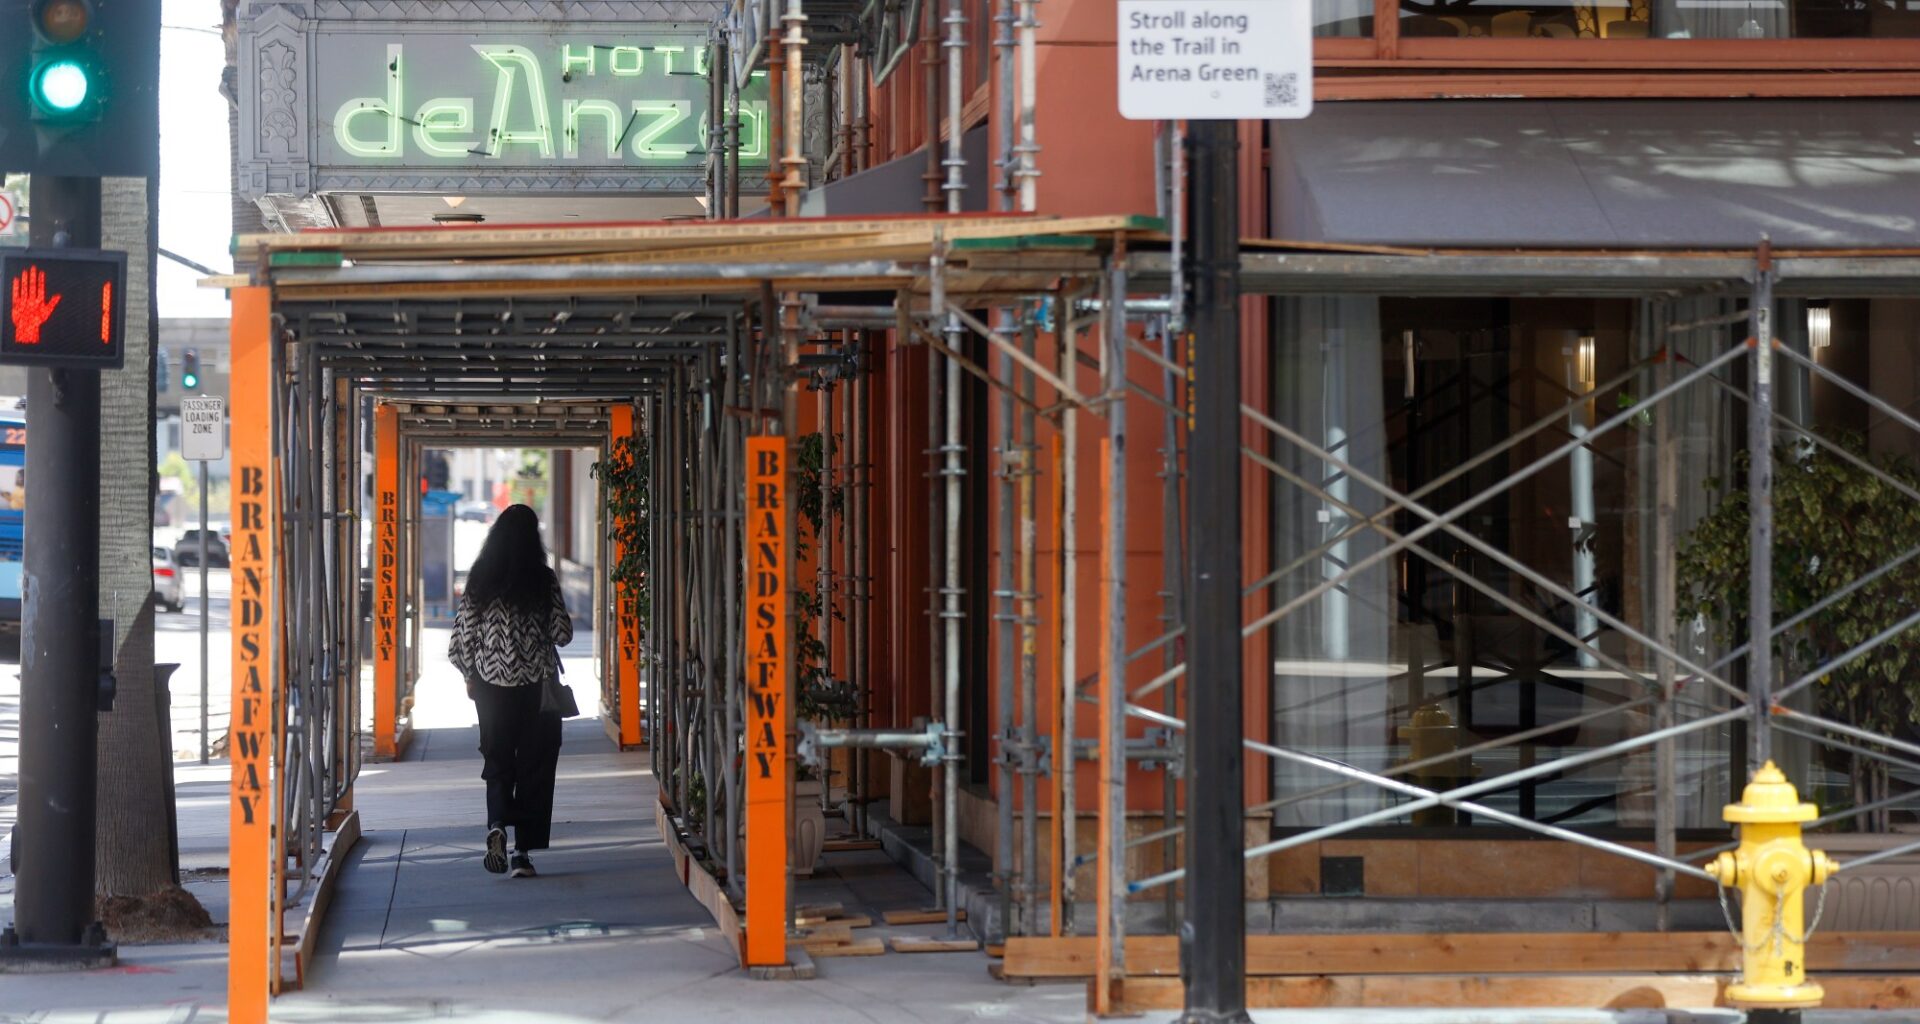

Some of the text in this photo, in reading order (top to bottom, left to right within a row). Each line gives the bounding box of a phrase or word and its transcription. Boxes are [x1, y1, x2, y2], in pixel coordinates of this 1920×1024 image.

[1130, 11, 1248, 34] Stroll along
[1131, 37, 1241, 56] the Trail in
[1131, 63, 1258, 81] Arena Green
[101, 280, 112, 345] 1
[185, 412, 219, 422] LOADING
[192, 423, 213, 434] ZONE
[379, 491, 396, 662] BRANDSAFWAY
[754, 450, 781, 779] BRANDSAFWAY
[236, 466, 265, 825] BRANDSAFWAY
